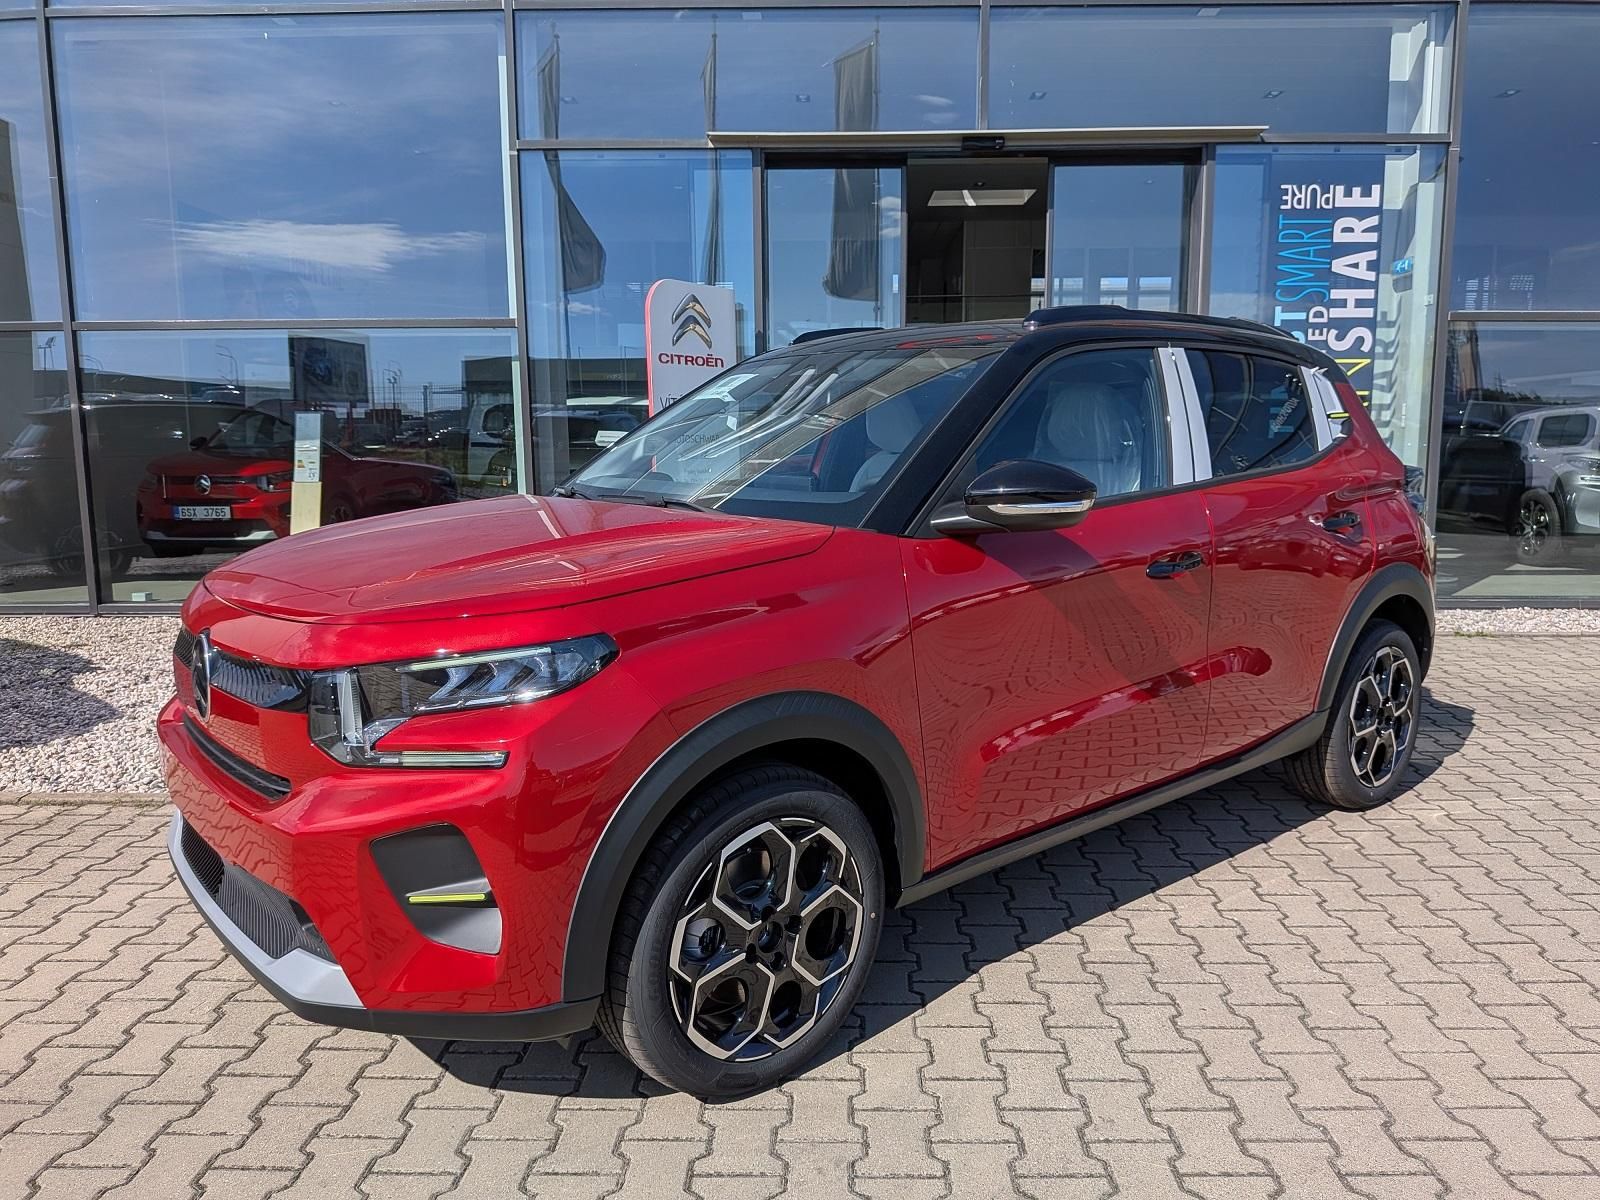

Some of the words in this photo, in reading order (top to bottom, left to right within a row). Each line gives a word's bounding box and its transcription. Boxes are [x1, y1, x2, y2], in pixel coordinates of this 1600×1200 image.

[1280, 184, 1334, 209] PURE
[1275, 214, 1333, 302] SMART
[1327, 184, 1381, 352] SHARE
[181, 508, 197, 517] 6SX
[203, 508, 226, 517] 3765
